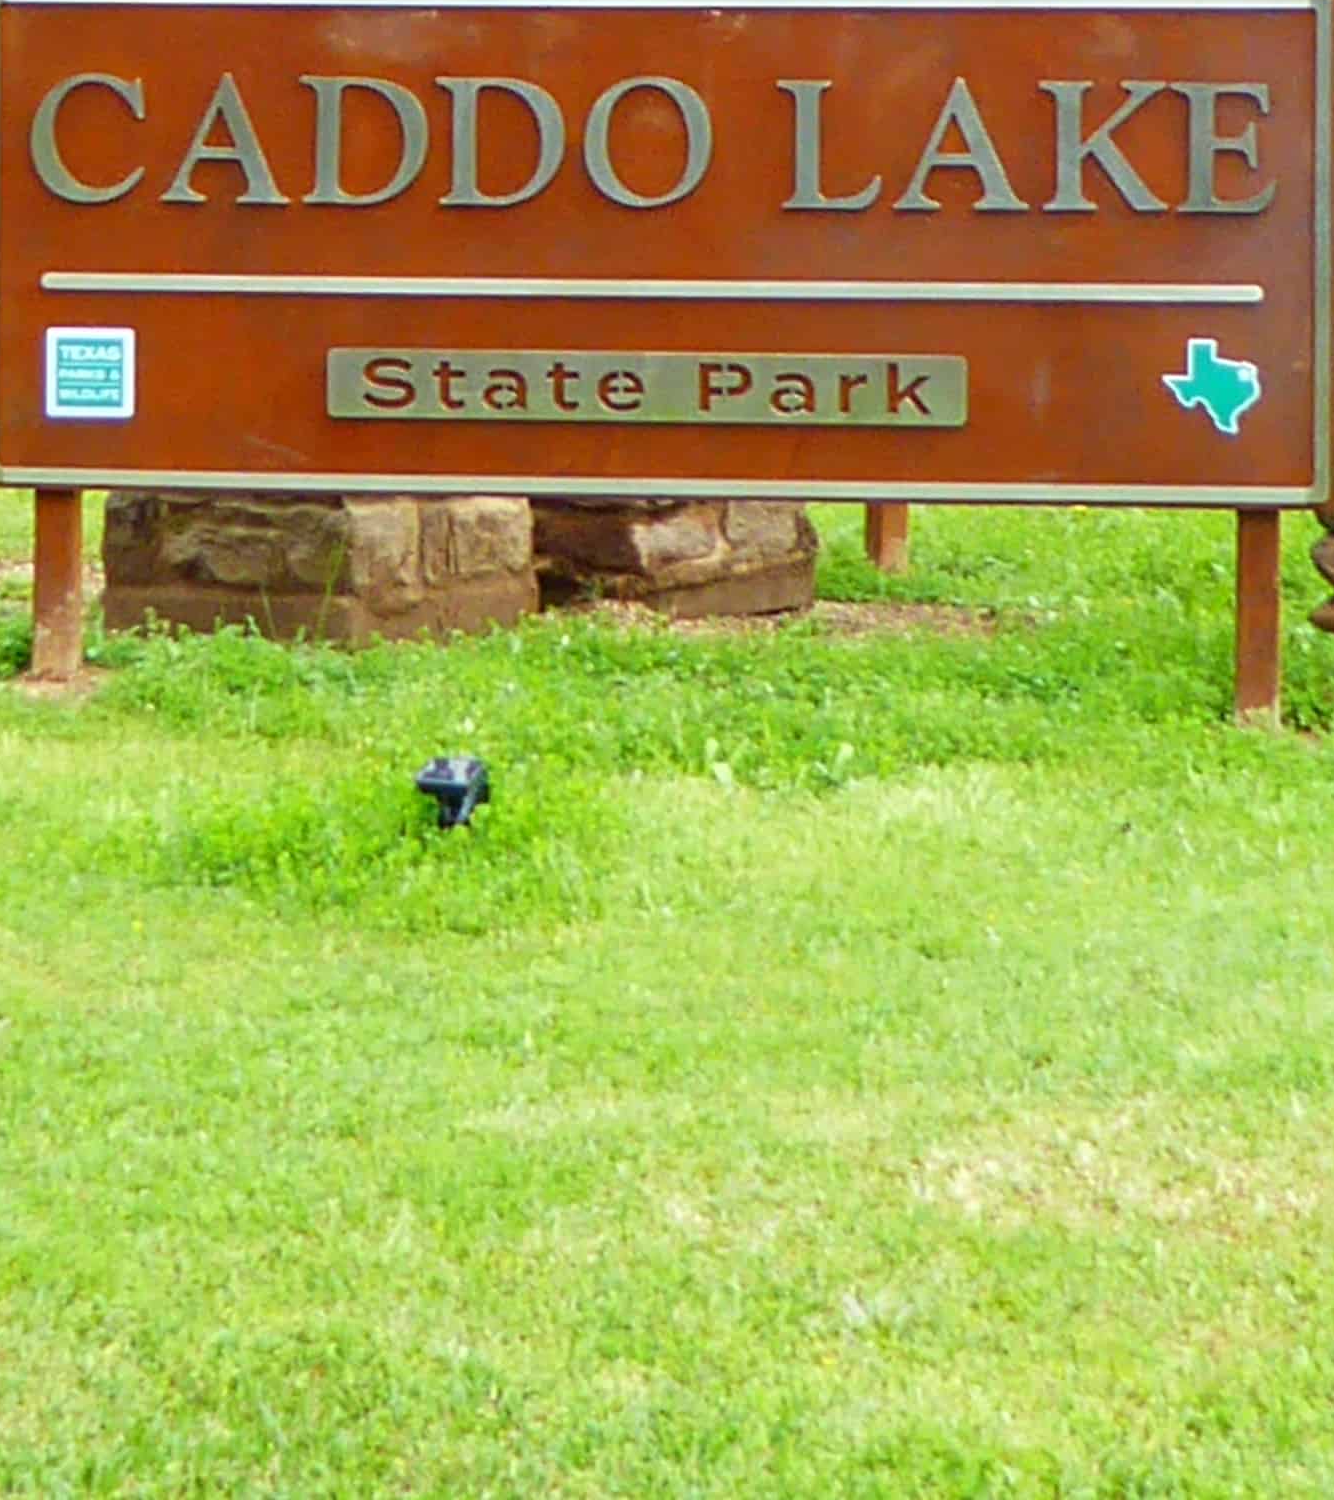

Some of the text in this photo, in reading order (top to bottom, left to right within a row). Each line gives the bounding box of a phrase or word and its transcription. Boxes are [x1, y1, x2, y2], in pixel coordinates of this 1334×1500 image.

[29, 71, 1278, 214] CADDO LAKE
[362, 357, 932, 416] State Park
